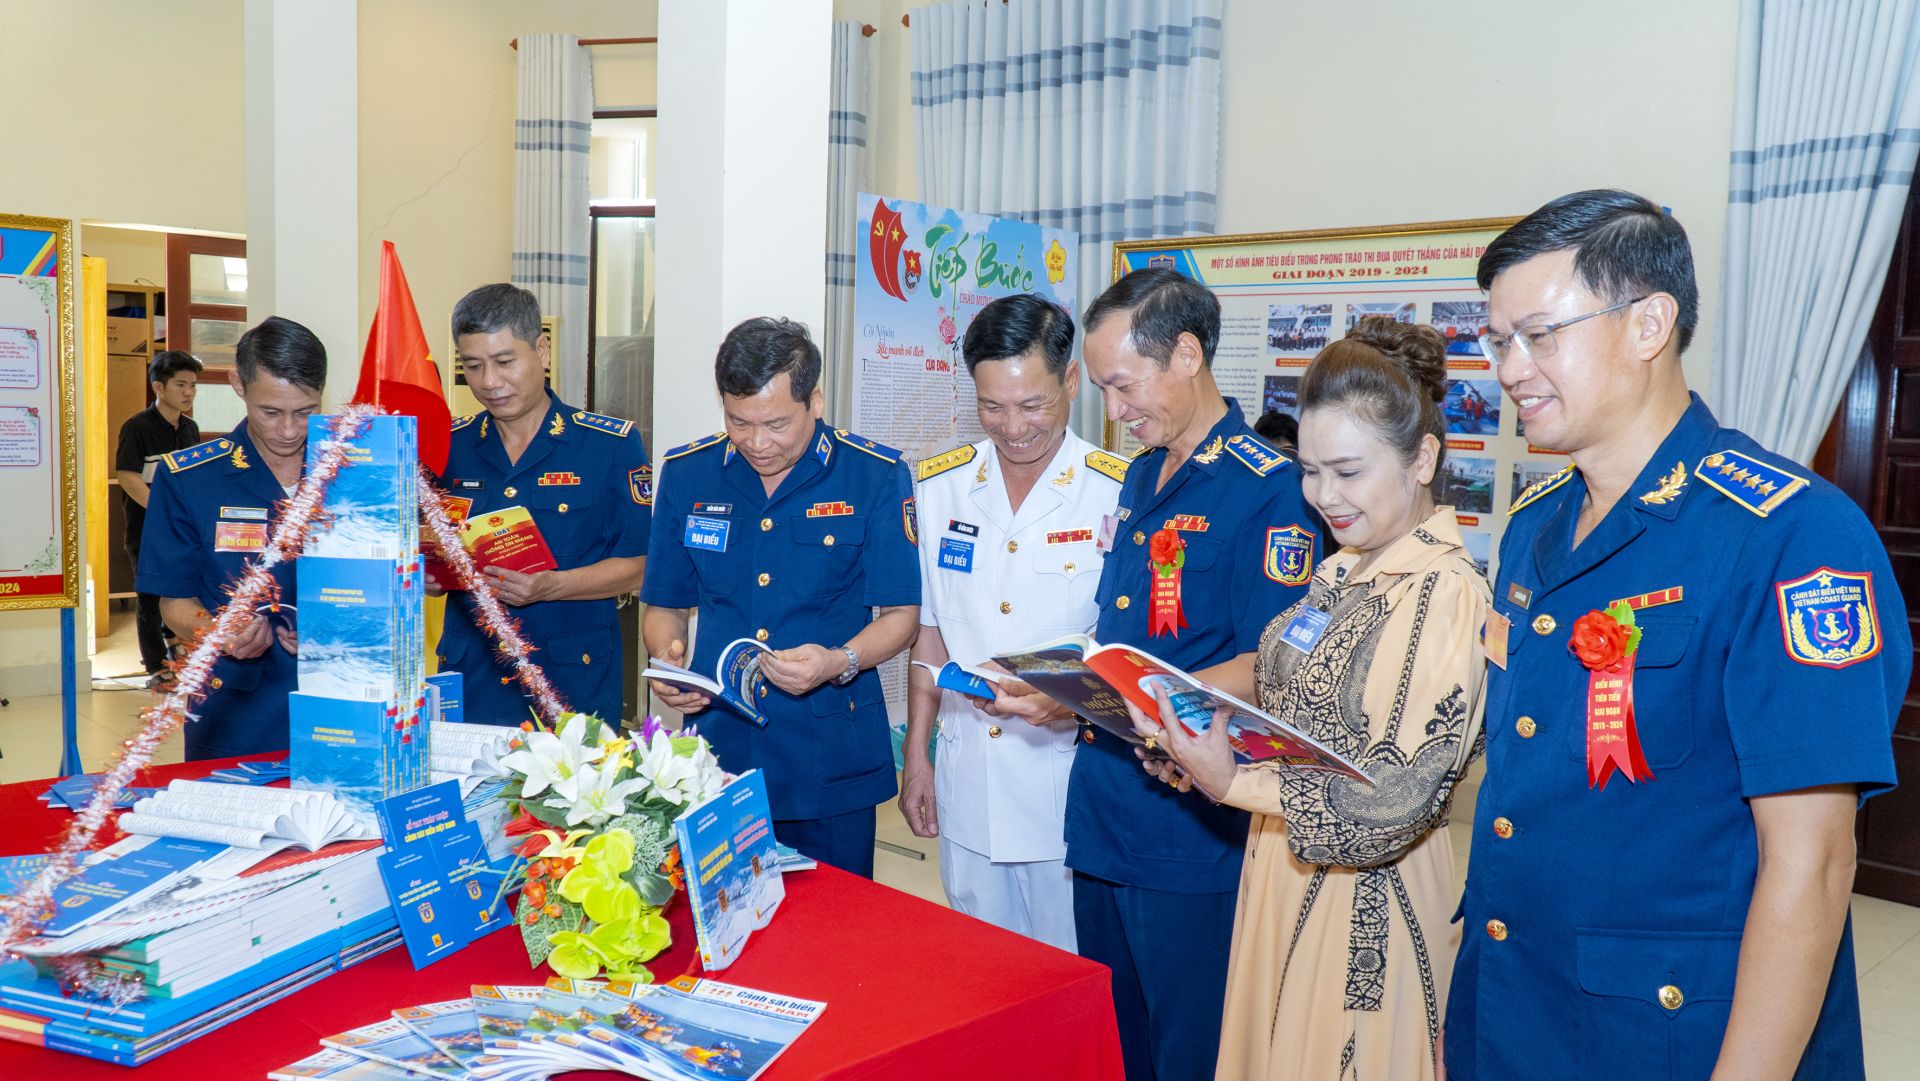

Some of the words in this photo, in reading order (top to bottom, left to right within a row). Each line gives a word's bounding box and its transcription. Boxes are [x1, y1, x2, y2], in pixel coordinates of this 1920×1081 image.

[925, 224, 969, 298] Tiếp
[975, 234, 1035, 291] Bước
[1211, 257, 1224, 270] MỘT
[1225, 255, 1234, 268] SỐ
[1235, 255, 1250, 268] HÌNH
[1251, 253, 1265, 267] ẢNH
[1266, 253, 1279, 266] TIÊU
[1280, 251, 1295, 266] BIỂU
[1297, 254, 1319, 265] TRONG
[1320, 253, 1342, 264] PHONG
[1345, 250, 1362, 263] TRÀO
[1364, 252, 1375, 262] THI
[1376, 251, 1391, 262] ĐUA
[1392, 247, 1415, 261] QUYẾT
[1417, 245, 1441, 260] THẮNG
[1443, 244, 1458, 259] CỦA
[1460, 243, 1473, 258] HẢI
[1272, 269, 1302, 279] GIAI
[1306, 268, 1345, 280] ĐOẠN
[1349, 267, 1382, 277] 2019
[1394, 266, 1429, 275] 2024
[493, 528, 510, 537] LUẬT
[503, 534, 519, 542] TOÀN
[691, 533, 703, 545] ĐẠI
[704, 532, 719, 546] BIỂU
[943, 554, 953, 566] ĐẠI
[954, 553, 967, 567] BIỂU
[1790, 591, 1808, 600] CẢNH
[1808, 588, 1820, 597] SÁT
[1820, 587, 1835, 596] BIỂN
[1835, 585, 1848, 594] VIỆT
[1848, 586, 1861, 594] NAM
[1793, 597, 1819, 607] VIETNAM
[1820, 595, 1840, 604] COAST
[1841, 594, 1862, 602] GUARD
[1595, 678, 1608, 689] ĐIỂN
[1608, 678, 1623, 688] HÌNH
[1595, 692, 1607, 702] TIÊN
[1608, 690, 1621, 701] TIẾN
[1594, 707, 1605, 716] GIAI
[1605, 706, 1620, 717] ĐOẠN
[1592, 721, 1605, 730] 2019
[1610, 720, 1623, 729] 2024
[737, 990, 768, 1002] Cảnh
[768, 997, 788, 1006] sát
[788, 1001, 816, 1012] biển
[775, 1008, 810, 1017] NAM
